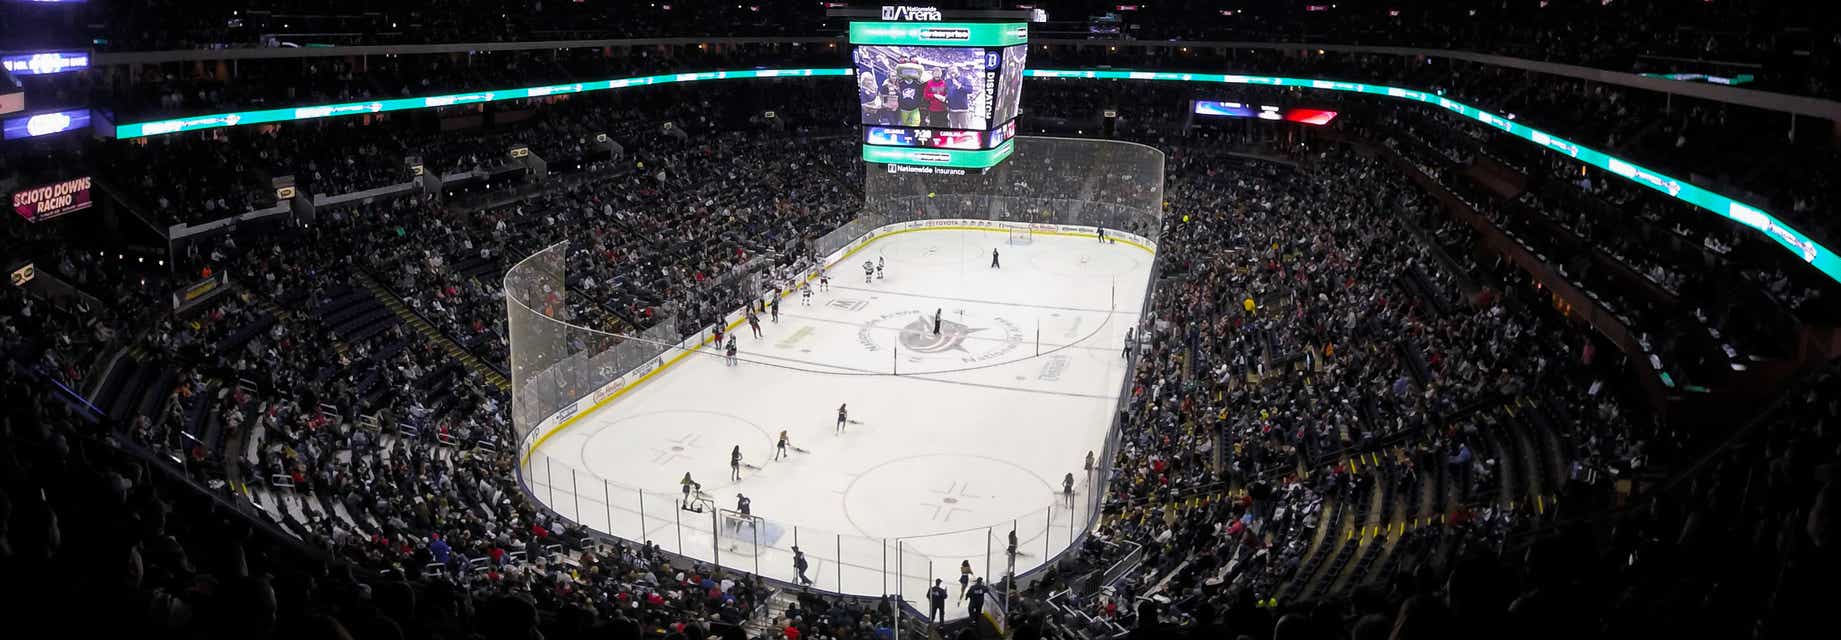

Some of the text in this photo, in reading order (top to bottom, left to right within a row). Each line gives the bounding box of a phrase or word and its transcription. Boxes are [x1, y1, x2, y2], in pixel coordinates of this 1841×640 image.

[894, 6, 941, 21] Arena
[986, 72, 995, 119] DISPATCH
[897, 164, 933, 173] Nationwide
[13, 176, 91, 207] SCIOTO DOWNS
[37, 194, 72, 214] RACINO
